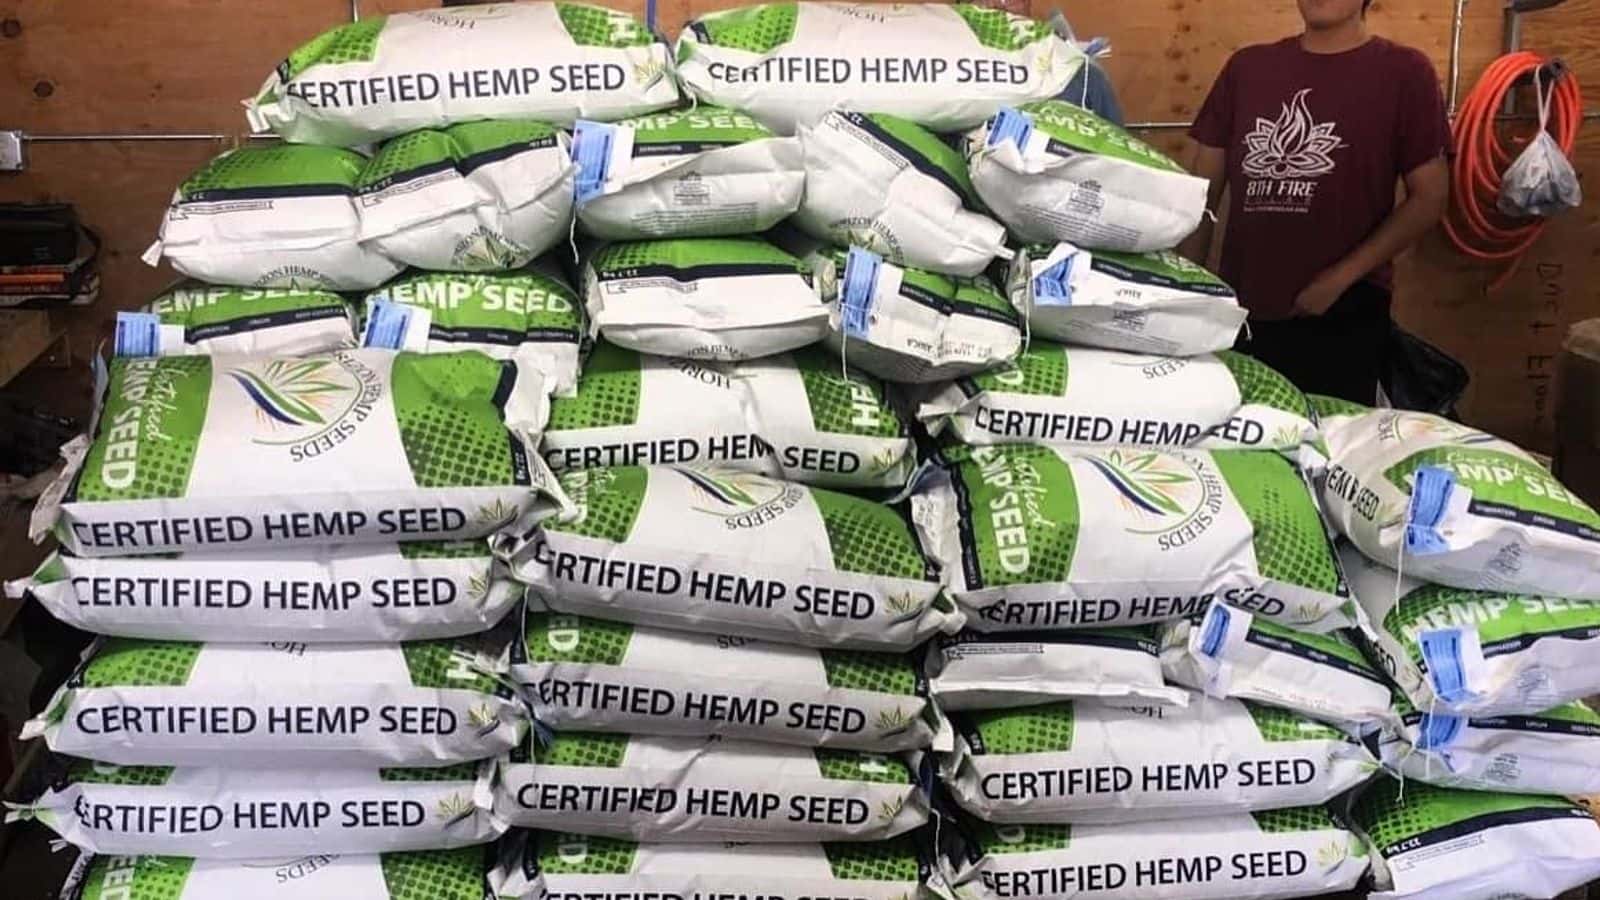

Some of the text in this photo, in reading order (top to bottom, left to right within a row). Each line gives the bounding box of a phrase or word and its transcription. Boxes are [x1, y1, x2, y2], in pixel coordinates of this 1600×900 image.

[449, 67, 540, 99] HEMP
[550, 64, 626, 93] SEED
[707, 57, 1029, 85] CERTIFIED HEMP SEED
[1246, 180, 1318, 196] 8TH FIRE
[151, 289, 230, 313] EMP
[480, 283, 574, 314] SEED
[102, 358, 158, 489] EMP SEED
[352, 383, 383, 424] HEMP
[289, 423, 356, 463] SEEDS
[975, 406, 1113, 442] CERTIFIED
[1119, 417, 1200, 447] HEMP
[543, 434, 861, 475] CERTIFIED HEM SEED
[71, 507, 467, 548] CERTIFIED HEMP SEED
[726, 503, 785, 530] SEEDS
[990, 491, 1030, 574] SEED
[1157, 512, 1214, 552] SEEDS
[71, 577, 457, 610] CERTIFIED HEMP SEED
[534, 543, 875, 620] CRTIFIED HEMP SEED
[76, 705, 457, 735] CERTIFIED HEMP SEED
[521, 679, 866, 734] ERTIFIED HEMP SEED
[981, 758, 1316, 800] CERTIFIED HEMP SEED
[234, 801, 331, 830] HEMP
[341, 800, 425, 828] SEED
[517, 782, 869, 825] CERTIFIED HEMP SEED
[981, 850, 1307, 898] CERTIFIED HEMP SEED
